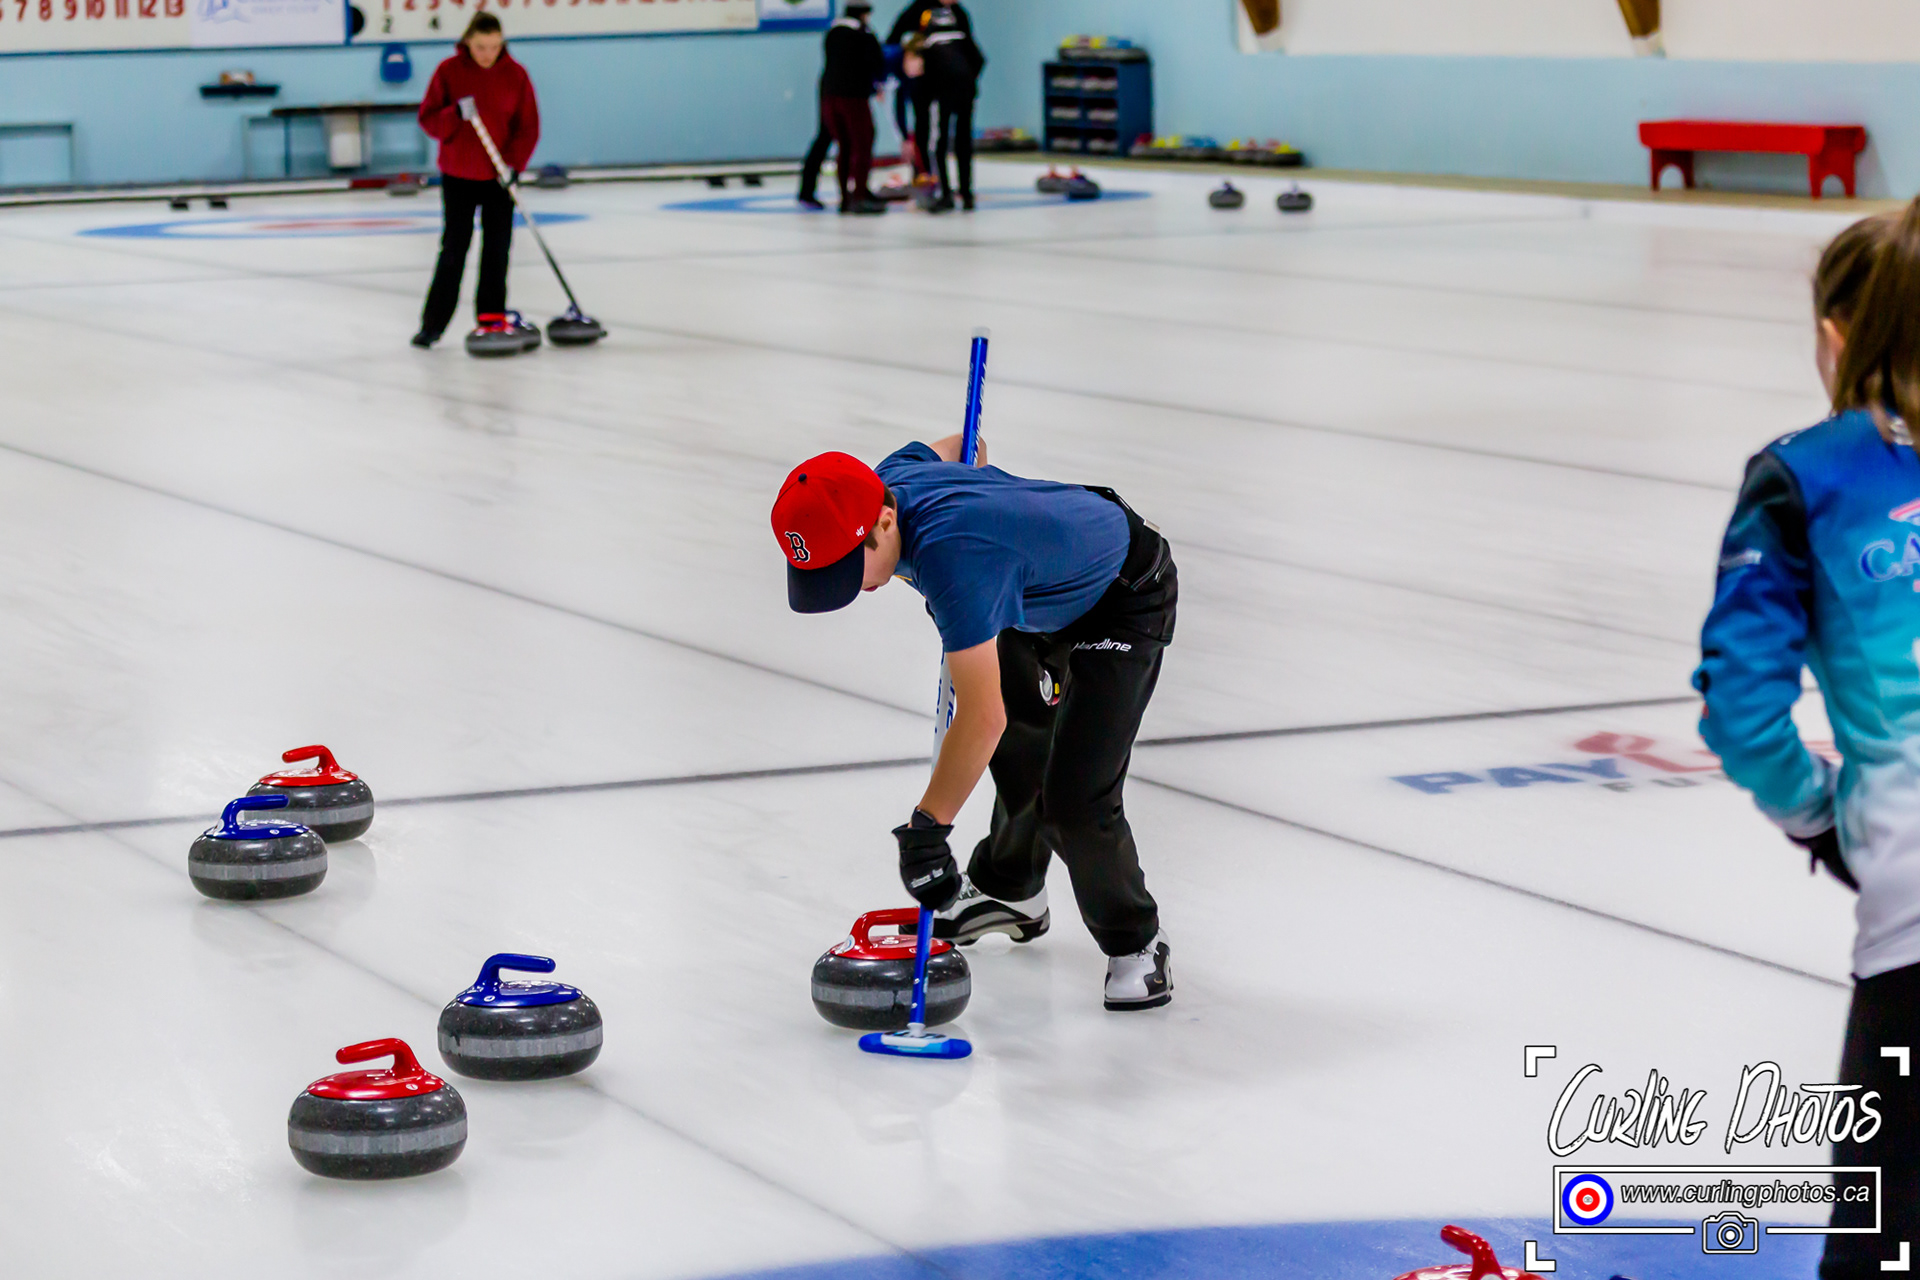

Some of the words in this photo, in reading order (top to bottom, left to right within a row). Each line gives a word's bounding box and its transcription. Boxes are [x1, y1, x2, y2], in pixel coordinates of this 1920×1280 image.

[14, 0, 27, 22] 7
[39, 0, 52, 22] 8
[64, 0, 77, 21] 9
[86, 0, 105, 20] 10
[115, 0, 129, 19] 11
[138, 0, 157, 19] 12
[785, 531, 811, 562] B
